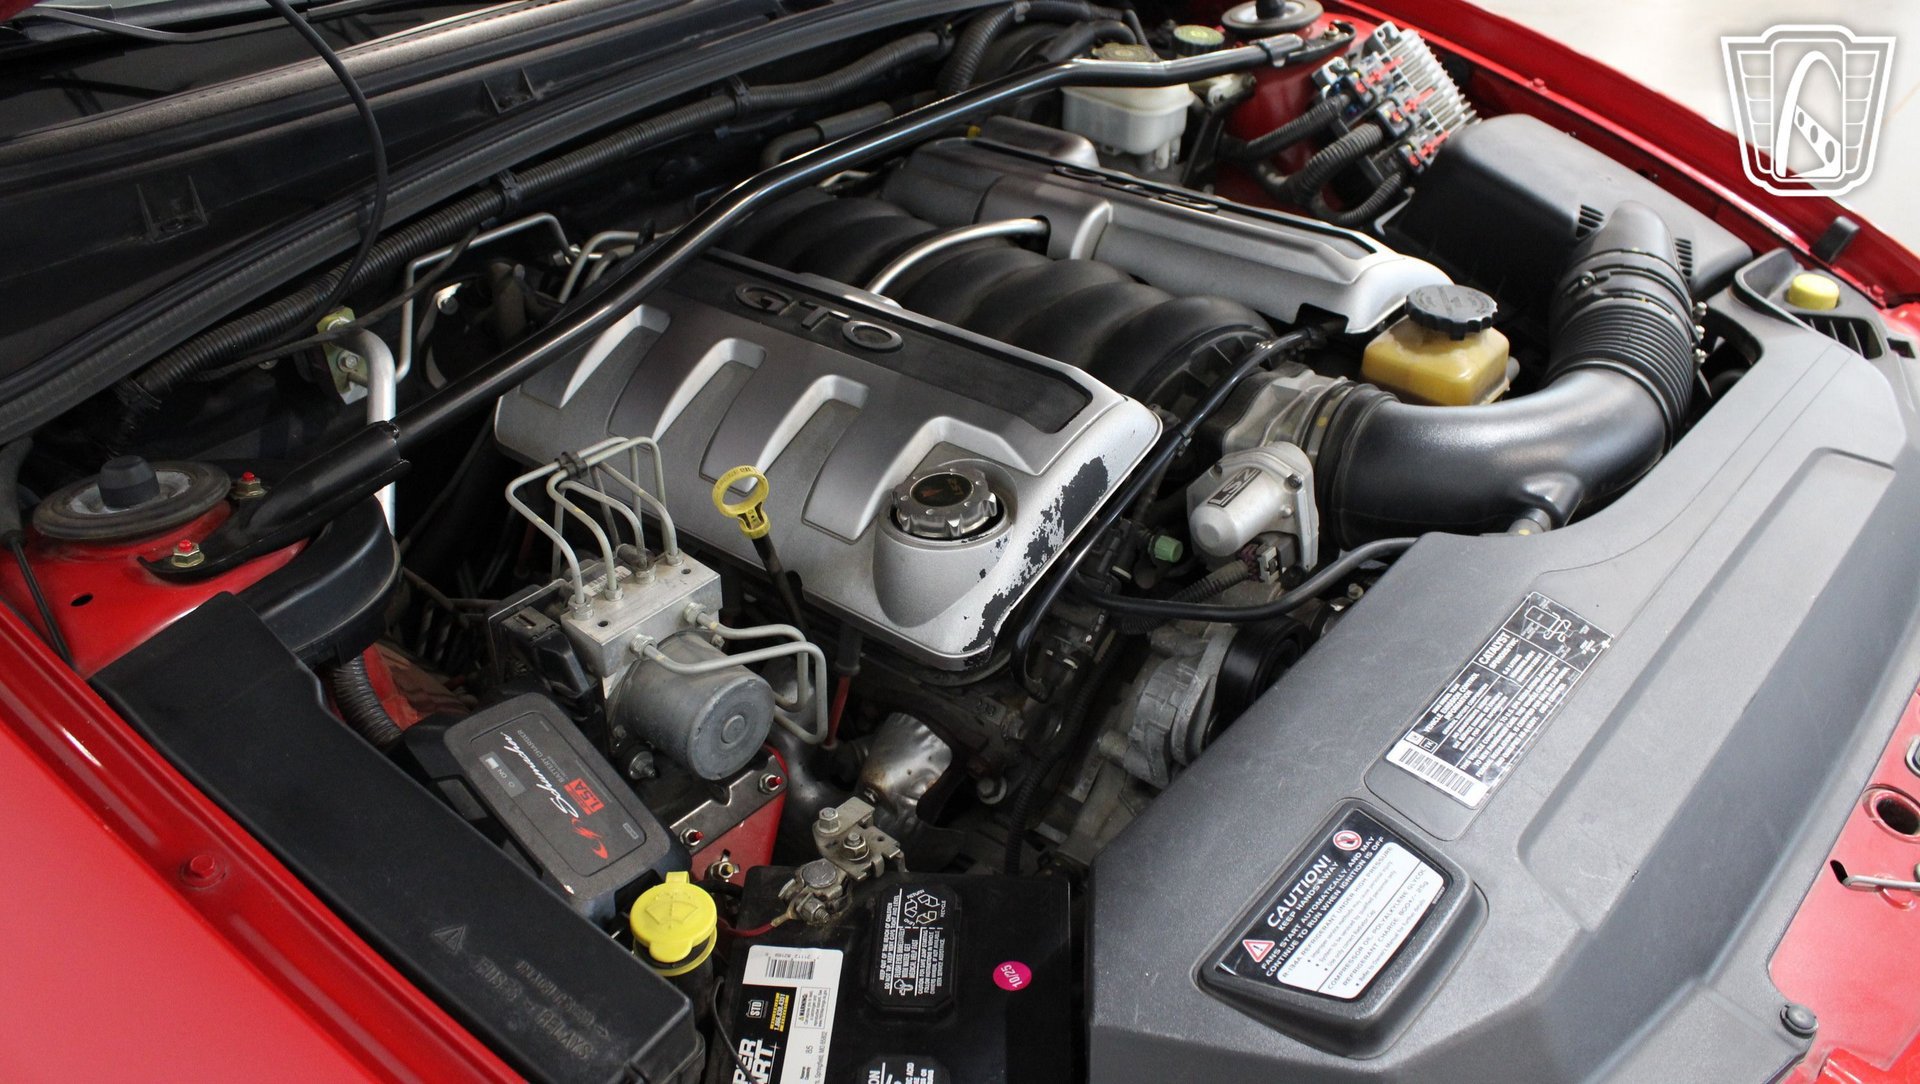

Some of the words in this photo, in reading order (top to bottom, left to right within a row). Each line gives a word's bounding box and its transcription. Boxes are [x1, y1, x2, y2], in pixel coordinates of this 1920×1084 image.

[735, 283, 904, 351] GTO
[1208, 467, 1254, 504] LS2
[1478, 632, 1510, 664] CATALYST
[1423, 713, 1444, 732] VEHICLE
[1440, 691, 1462, 714] EMISSION
[1459, 673, 1480, 693] CONTROL
[1444, 690, 1473, 721] INFORMATION
[517, 729, 543, 758] CHARGER
[503, 734, 579, 818] Schumacher
[540, 756, 565, 782] BATTERY
[574, 780, 600, 809] 1.5A
[1261, 948, 1281, 969] FANS
[1279, 923, 1301, 948] START
[1348, 852, 1362, 868] AND
[1360, 836, 1374, 852] MAY
[1266, 940, 1299, 976] CONTINUE
[1297, 928, 1308, 938] TO
[1306, 912, 1322, 928] RUN
[1320, 889, 1341, 911] WHEN
[1339, 859, 1366, 889] IGNITION
[1364, 851, 1373, 859] IS
[1371, 836, 1384, 851] OFF
[1267, 855, 1331, 927] CAUTION!
[1278, 911, 1296, 931] KEEP
[1295, 883, 1320, 910] HANDS
[1317, 861, 1338, 884] AWAY
[1300, 914, 1336, 956] REFRIGERANT
[1336, 892, 1355, 914] UNDER
[1354, 878, 1367, 892] HIGH
[1365, 847, 1392, 877] PRESSURE
[1000, 964, 1023, 988] 10/25
[1327, 946, 1364, 990] COMPRESSOR
[1342, 943, 1378, 986] REFRIGERANT
[750, 1001, 762, 1016] STD
[536, 1007, 595, 1060] RELAYS
